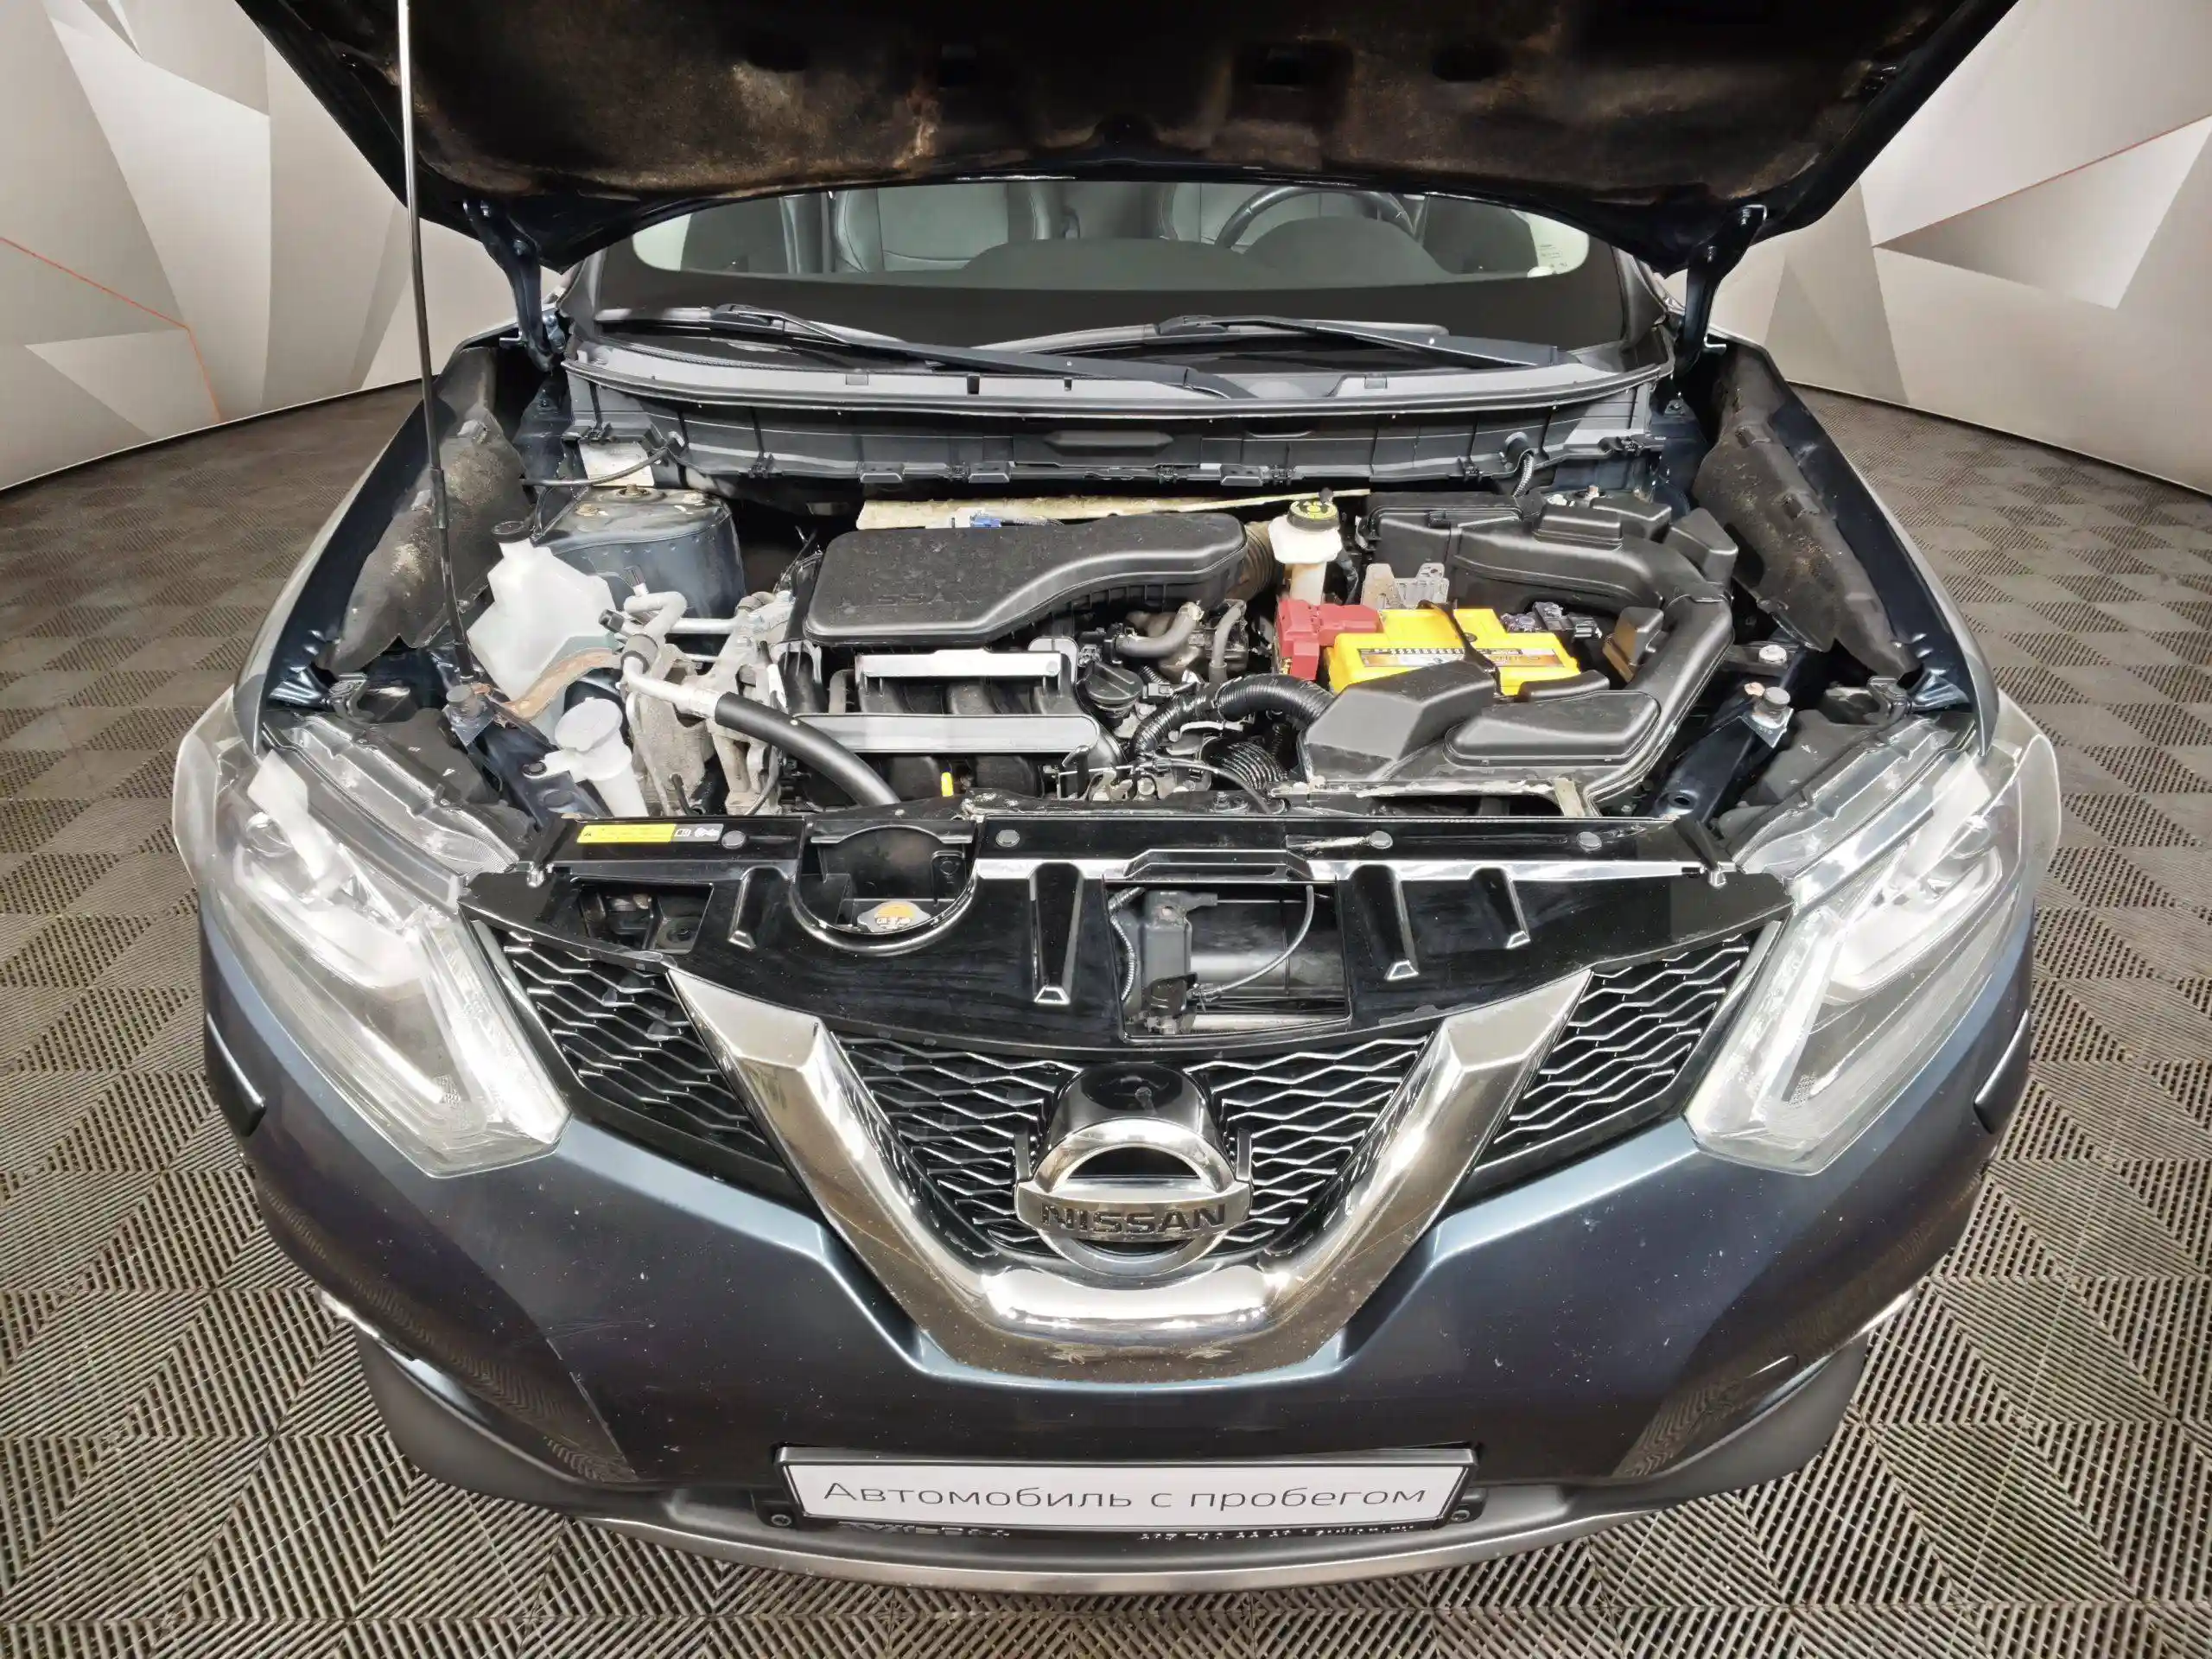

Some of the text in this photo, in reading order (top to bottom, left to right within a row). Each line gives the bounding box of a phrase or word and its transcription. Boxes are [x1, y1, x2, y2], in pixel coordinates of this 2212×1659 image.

[1041, 1204, 1226, 1234] NISSAN
[823, 1482, 1426, 1511] Автомобиль с пробегом
